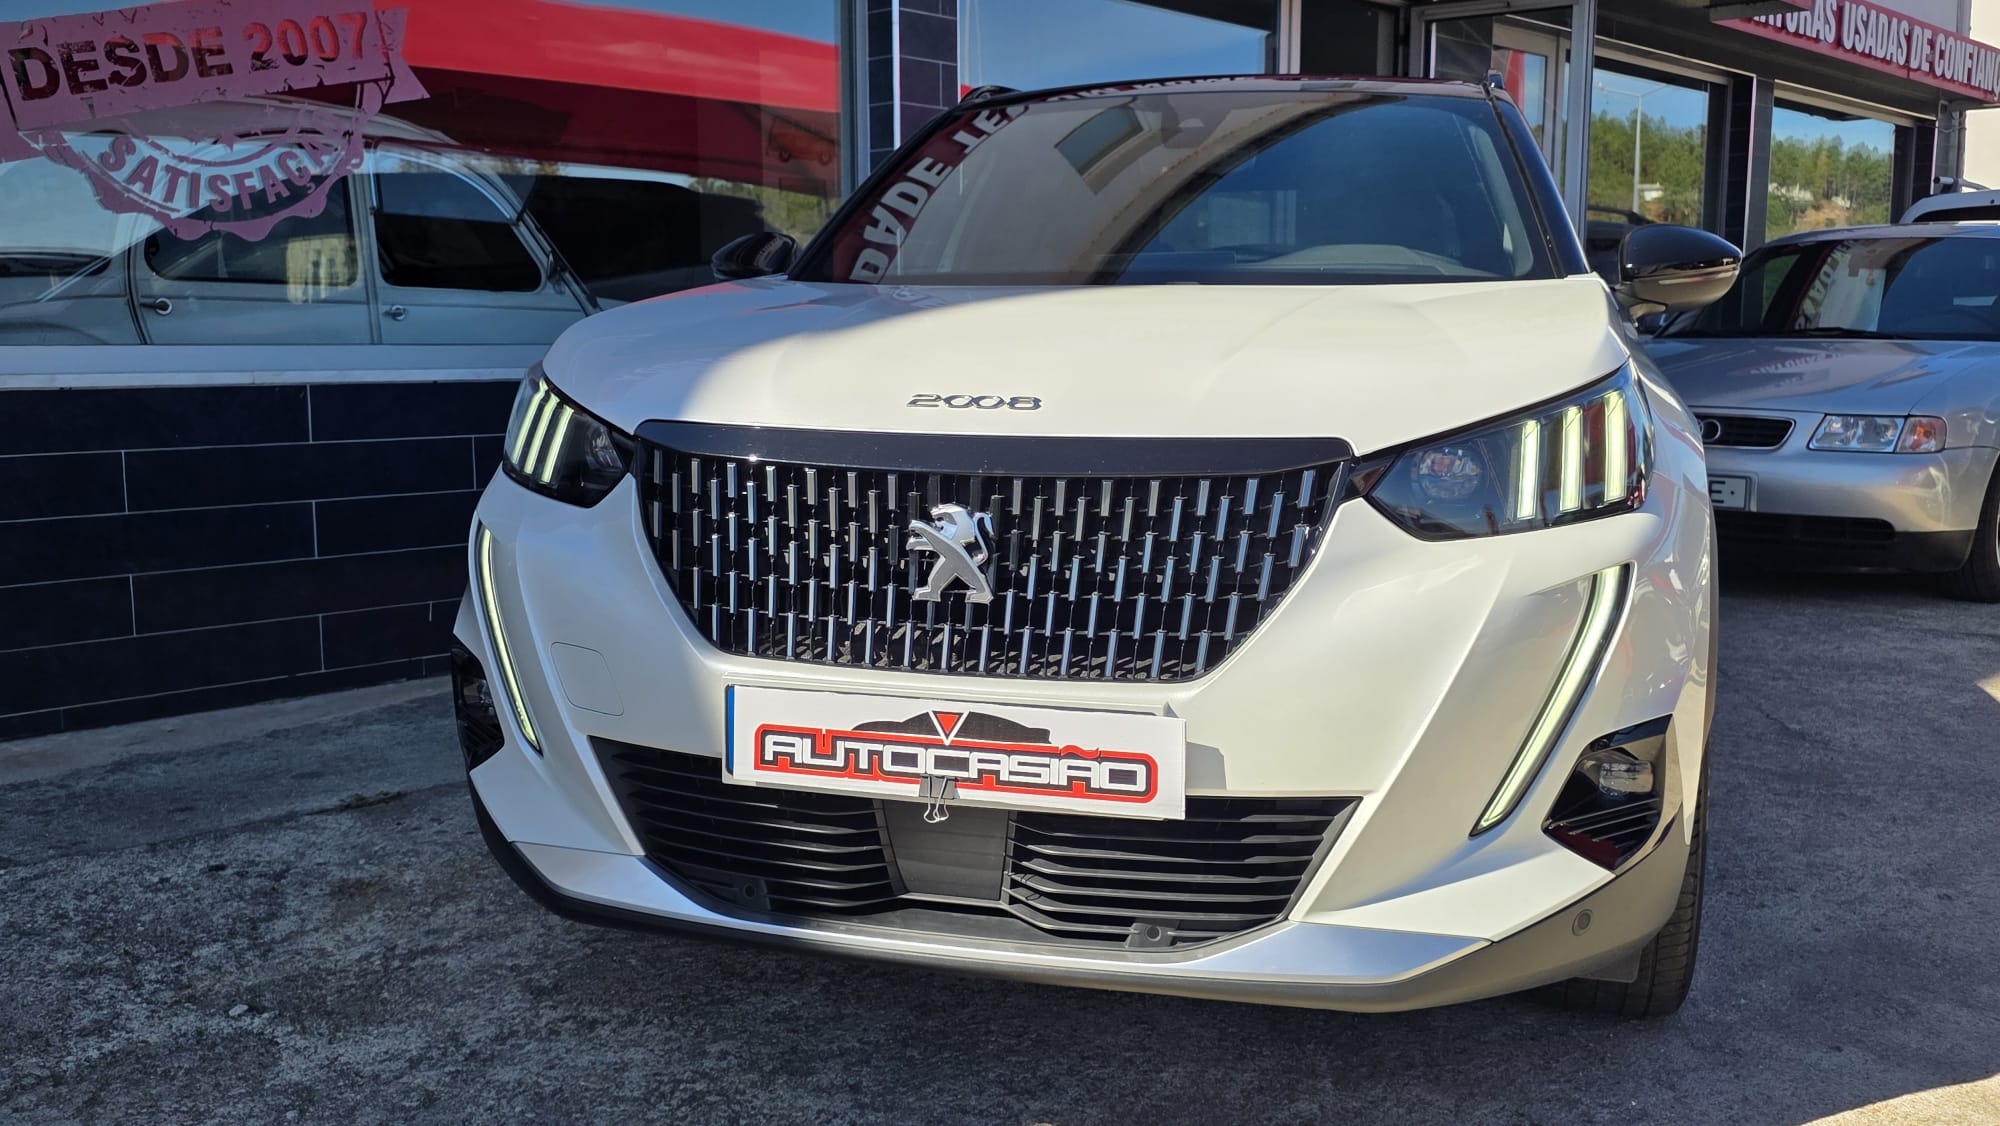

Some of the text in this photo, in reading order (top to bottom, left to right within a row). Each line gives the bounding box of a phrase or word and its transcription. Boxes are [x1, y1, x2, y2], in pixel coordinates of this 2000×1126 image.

[7, 11, 367, 101] DESDE 2007
[1842, 2, 1909, 66] USADAS
[1909, 25, 1932, 73] DE
[906, 393, 1042, 411] 2008
[763, 734, 1148, 793] AUTOCASIÃO
